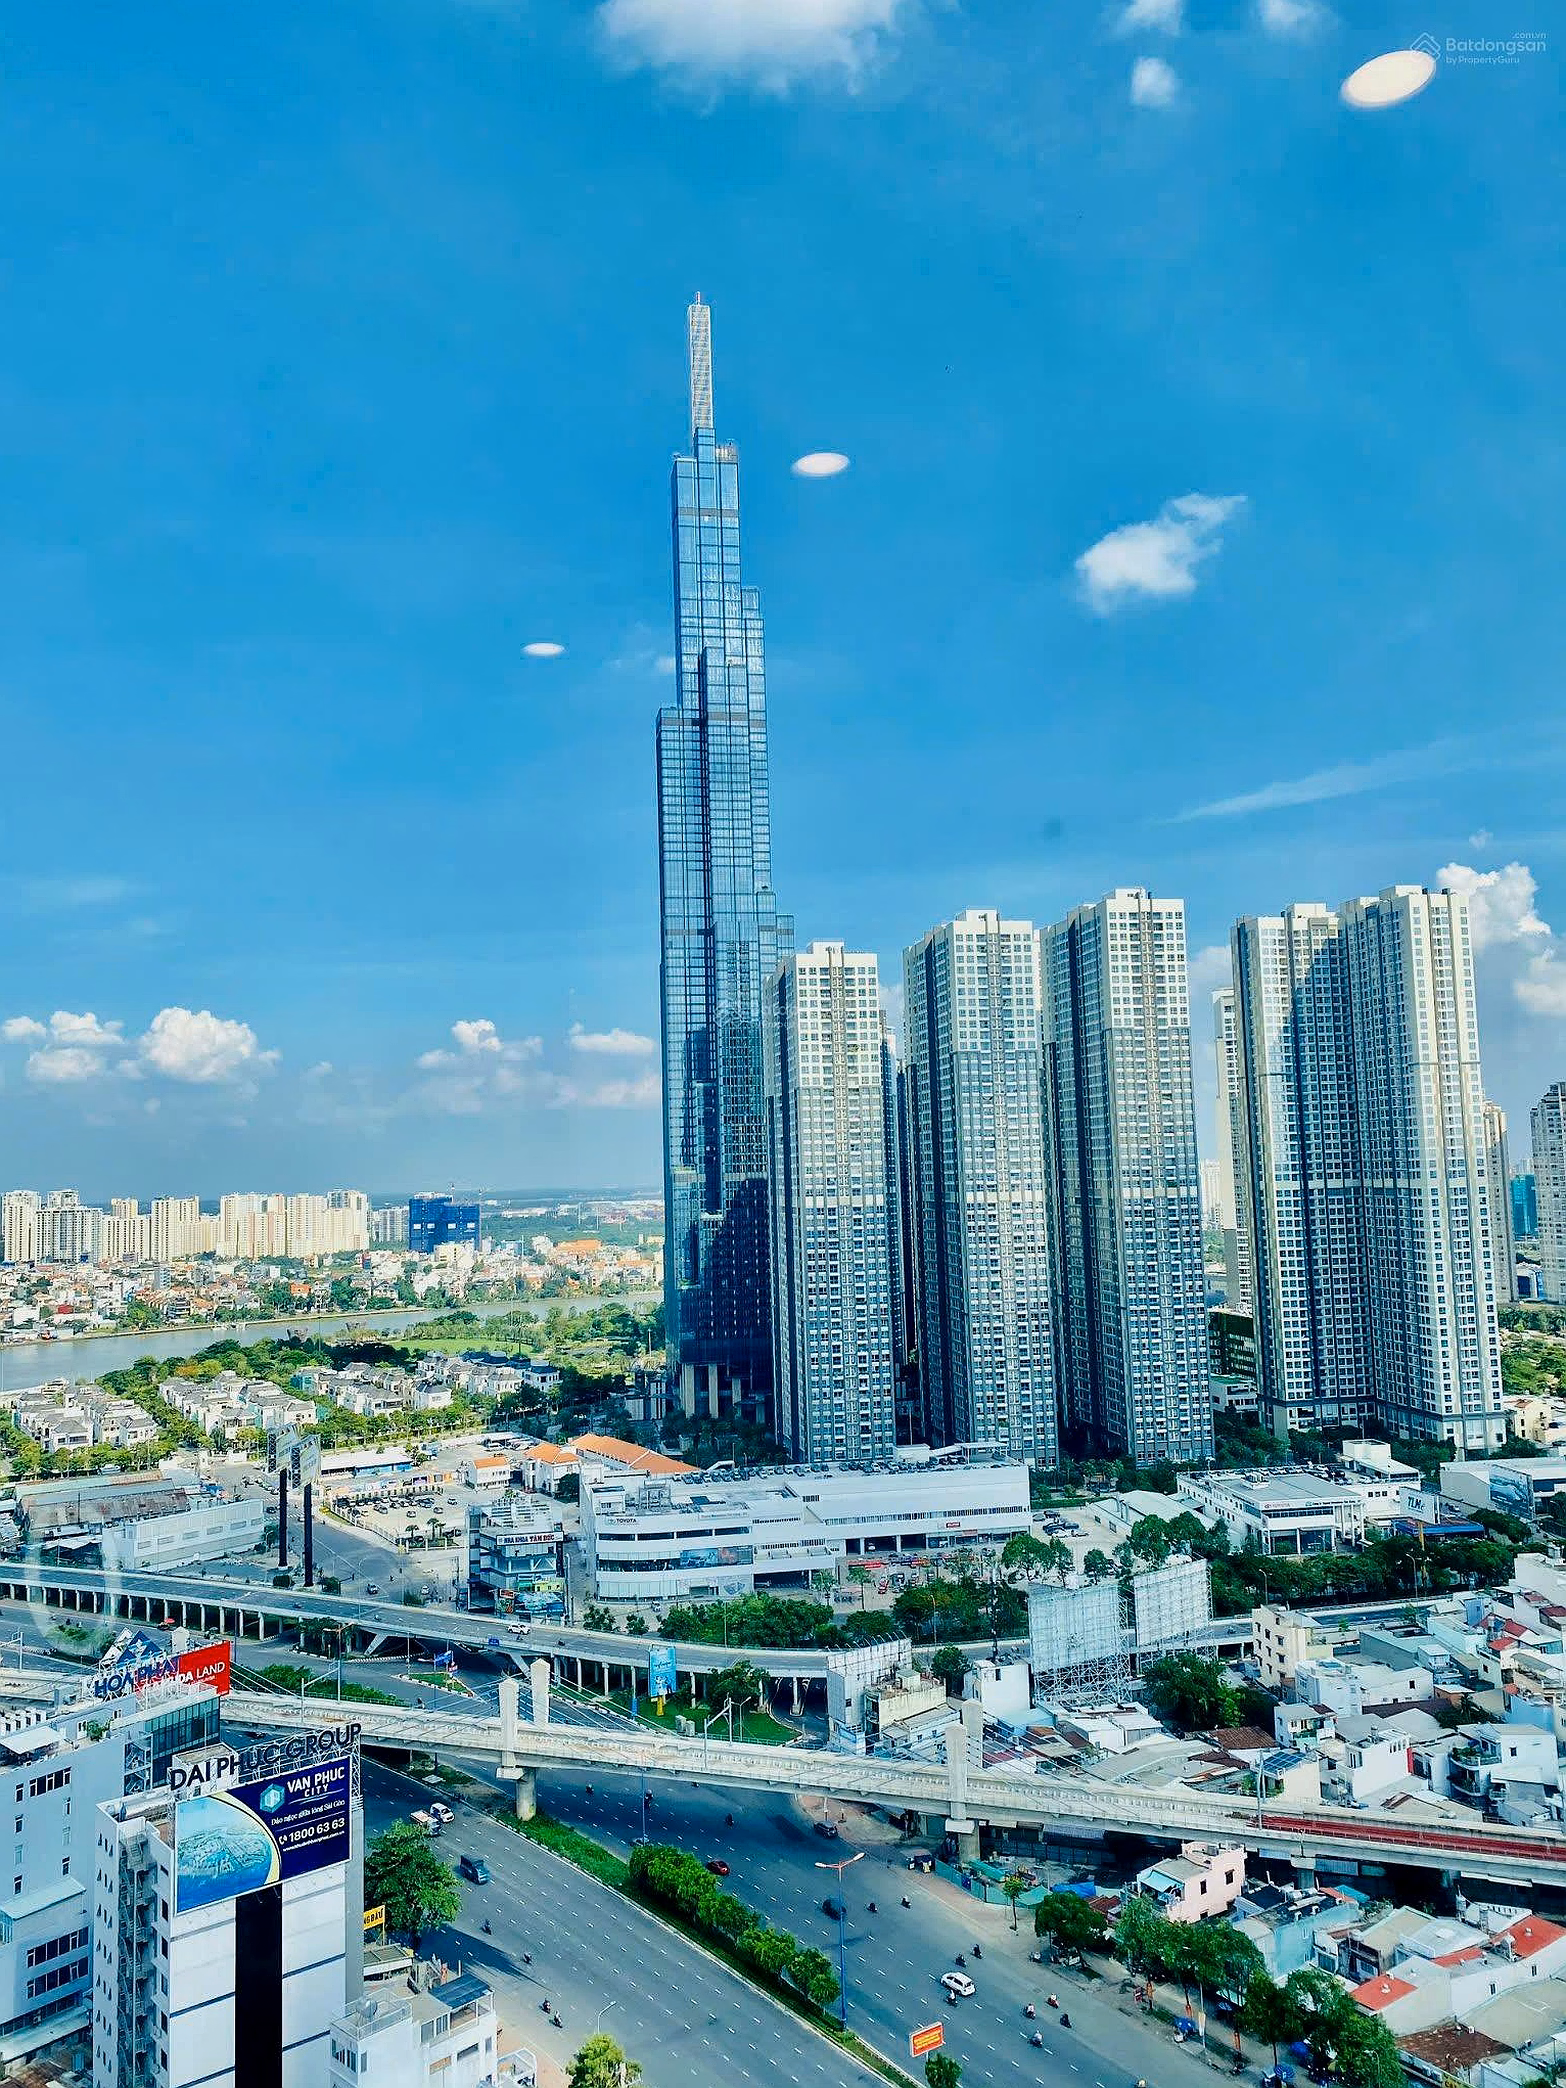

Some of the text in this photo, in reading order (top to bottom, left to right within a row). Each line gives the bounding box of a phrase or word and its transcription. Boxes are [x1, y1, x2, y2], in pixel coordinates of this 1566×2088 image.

[196, 1661, 225, 1680] LAND
[171, 1723, 361, 1790] DAI PHUC GROUP
[287, 1767, 345, 1793] VAN PHUC
[304, 1784, 328, 1797] CITY
[289, 1817, 345, 1842] 1800 63 63
